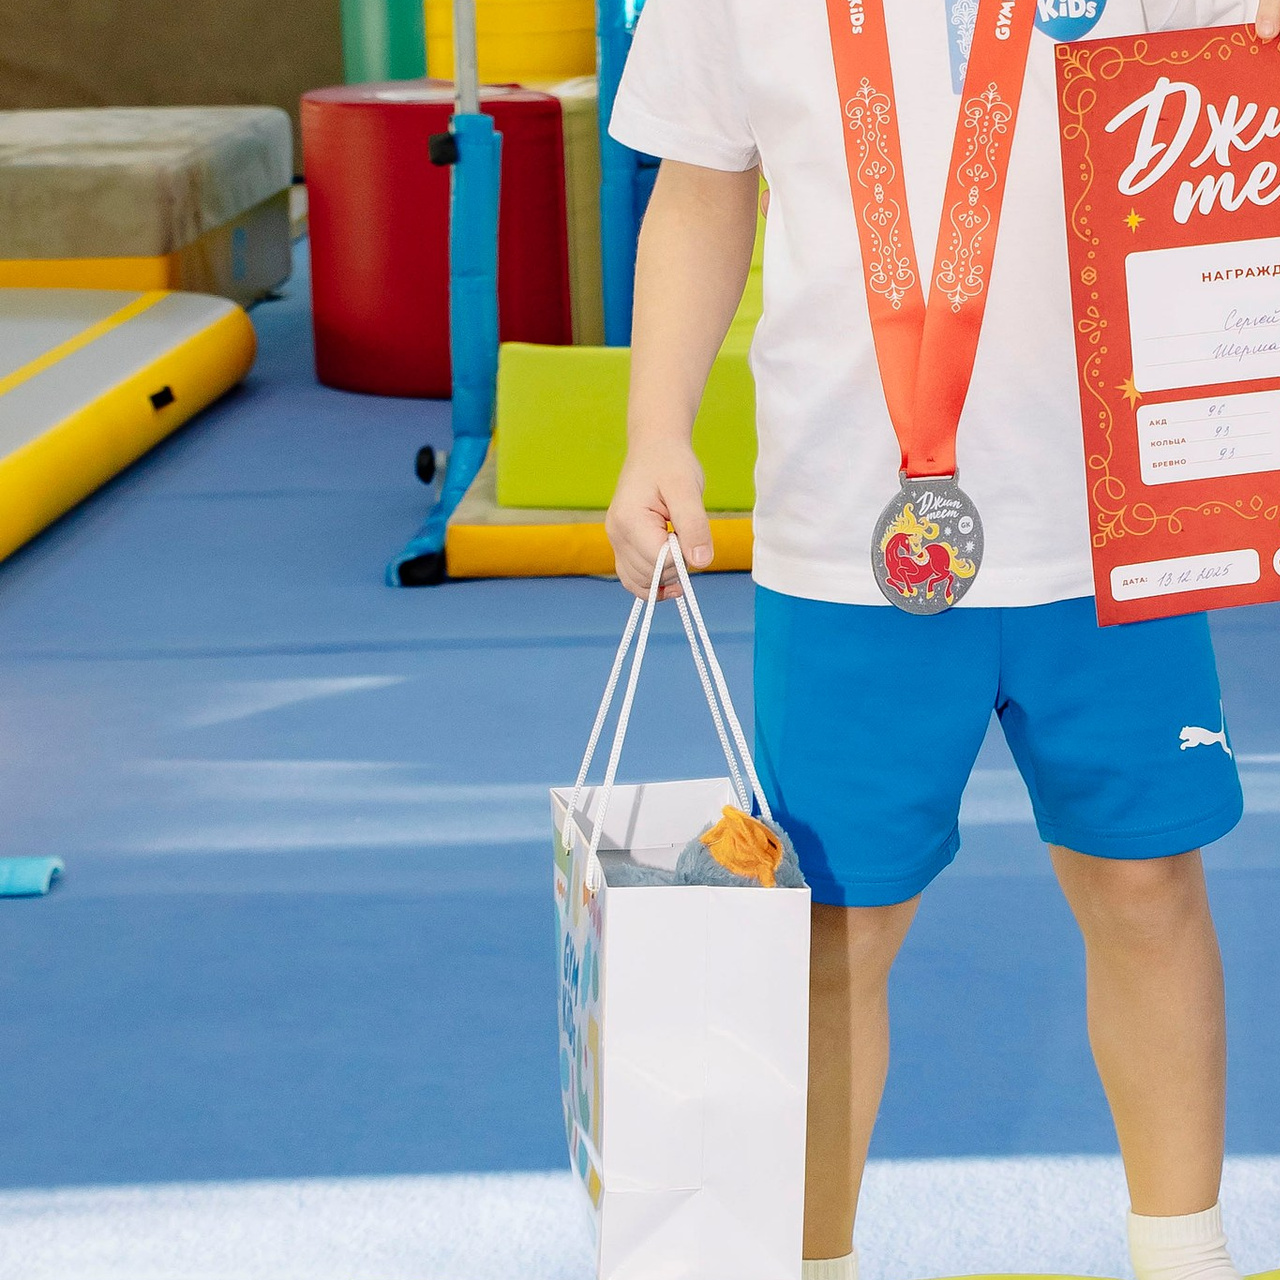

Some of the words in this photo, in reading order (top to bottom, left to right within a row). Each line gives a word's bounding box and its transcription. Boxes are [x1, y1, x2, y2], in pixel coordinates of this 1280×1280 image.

[1149, 418, 1168, 426] АКД
[1150, 437, 1186, 448] КОЛЬЦА
[1152, 458, 1187, 469] БРЕВНО
[1122, 576, 1149, 587] ДАТА:
